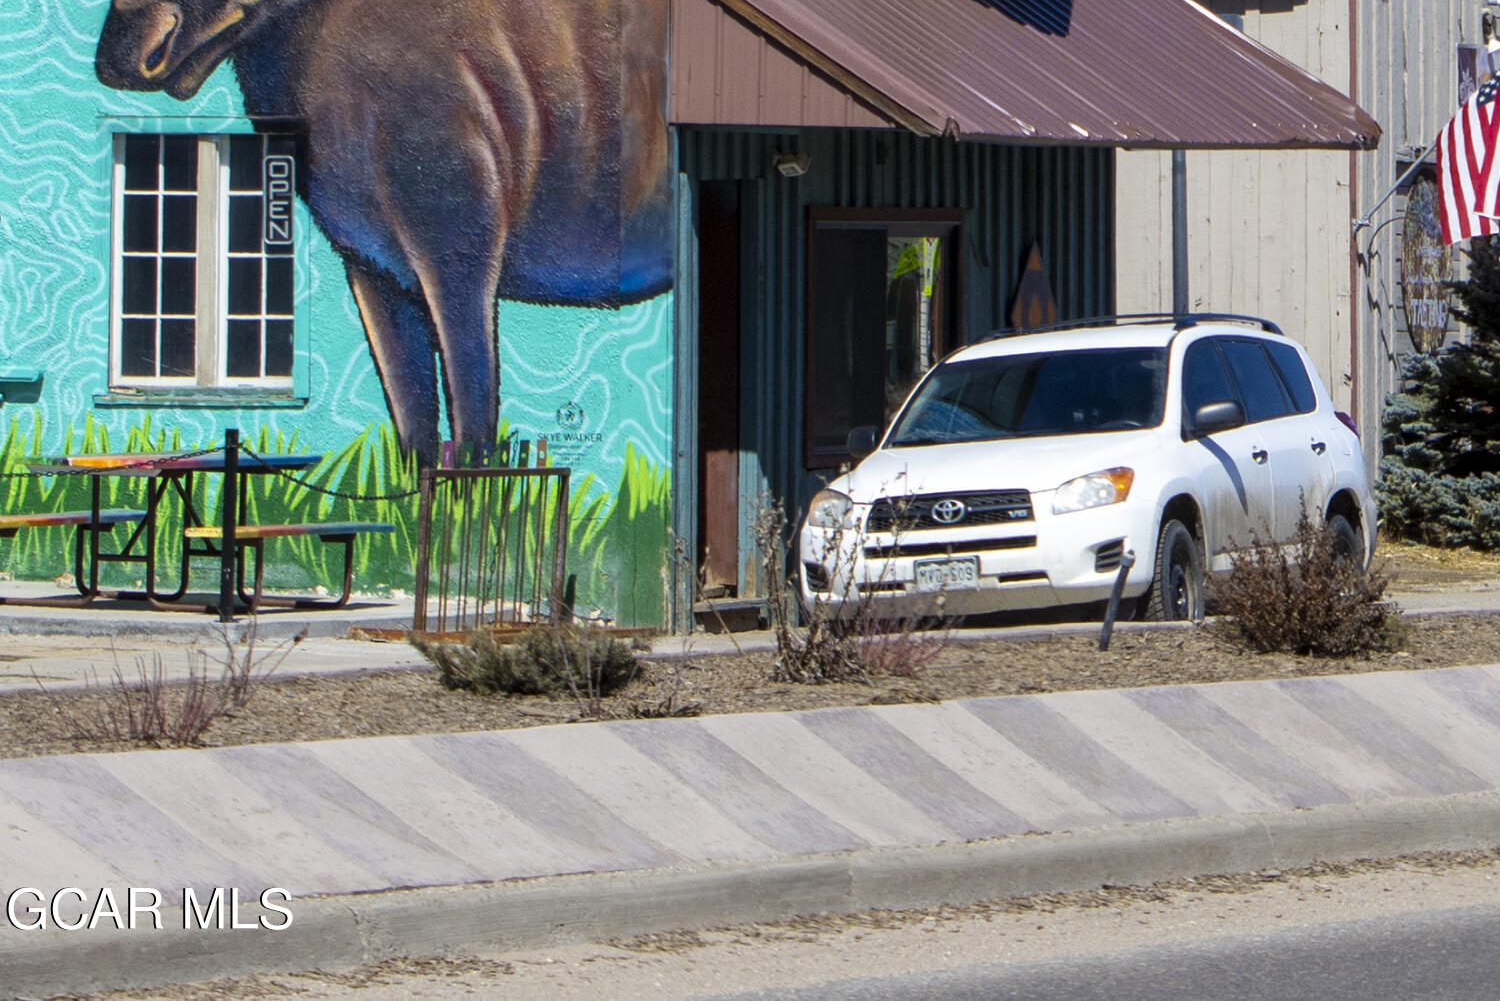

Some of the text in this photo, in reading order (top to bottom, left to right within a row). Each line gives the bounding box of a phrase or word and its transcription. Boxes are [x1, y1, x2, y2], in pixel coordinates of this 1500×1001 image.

[269, 161, 289, 240] OPEN
[563, 432, 603, 442] WALKER
[1008, 509, 1028, 518] V6
